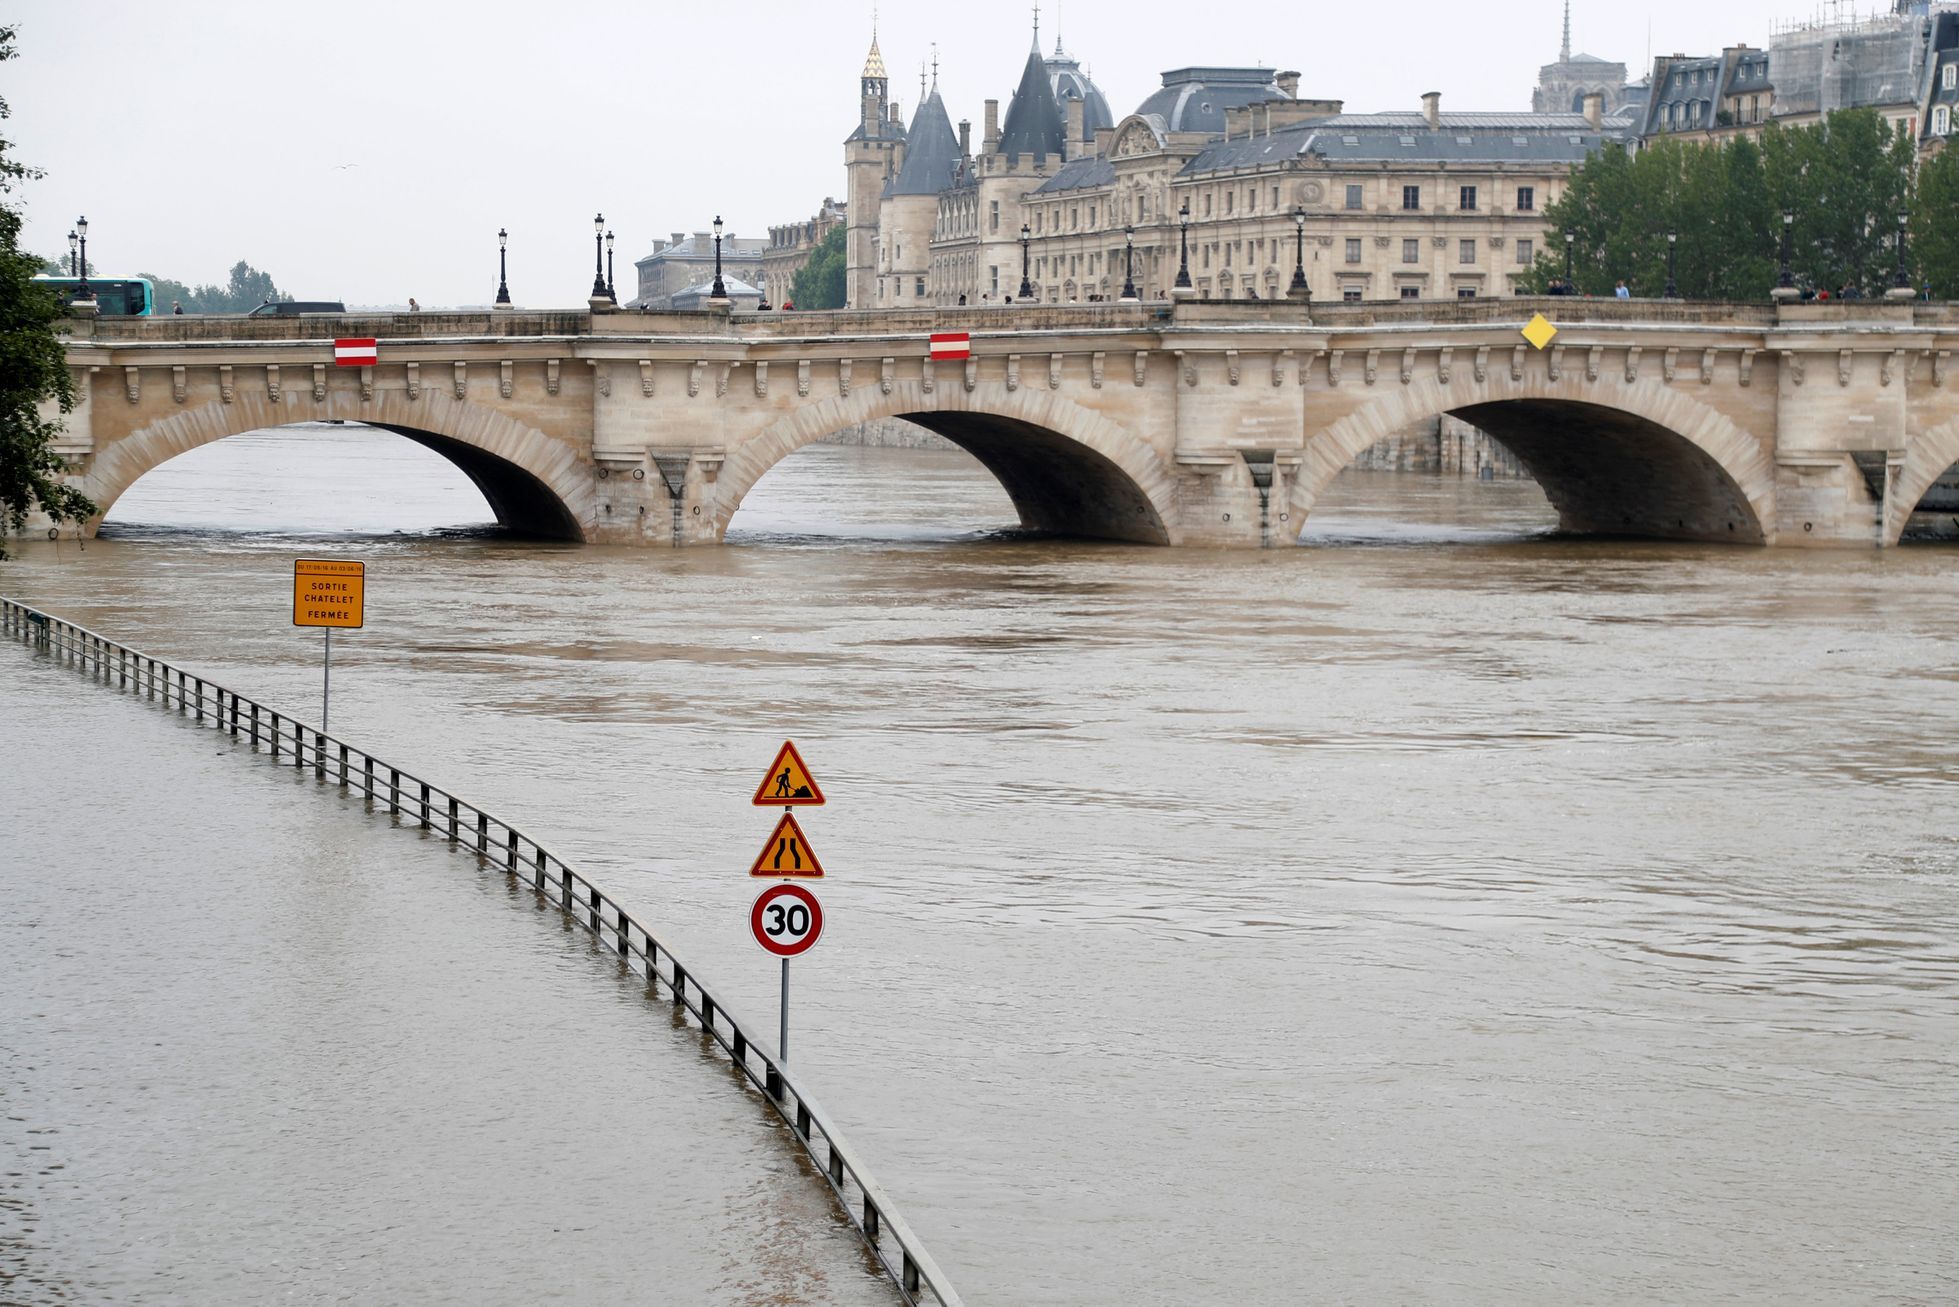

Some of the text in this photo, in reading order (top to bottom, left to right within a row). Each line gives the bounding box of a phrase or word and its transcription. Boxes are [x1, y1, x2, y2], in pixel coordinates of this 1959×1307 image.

[312, 582, 348, 591] SORTIE
[304, 594, 354, 604] CHATELET
[308, 610, 349, 620] FERMÉE
[766, 904, 810, 936] 30
